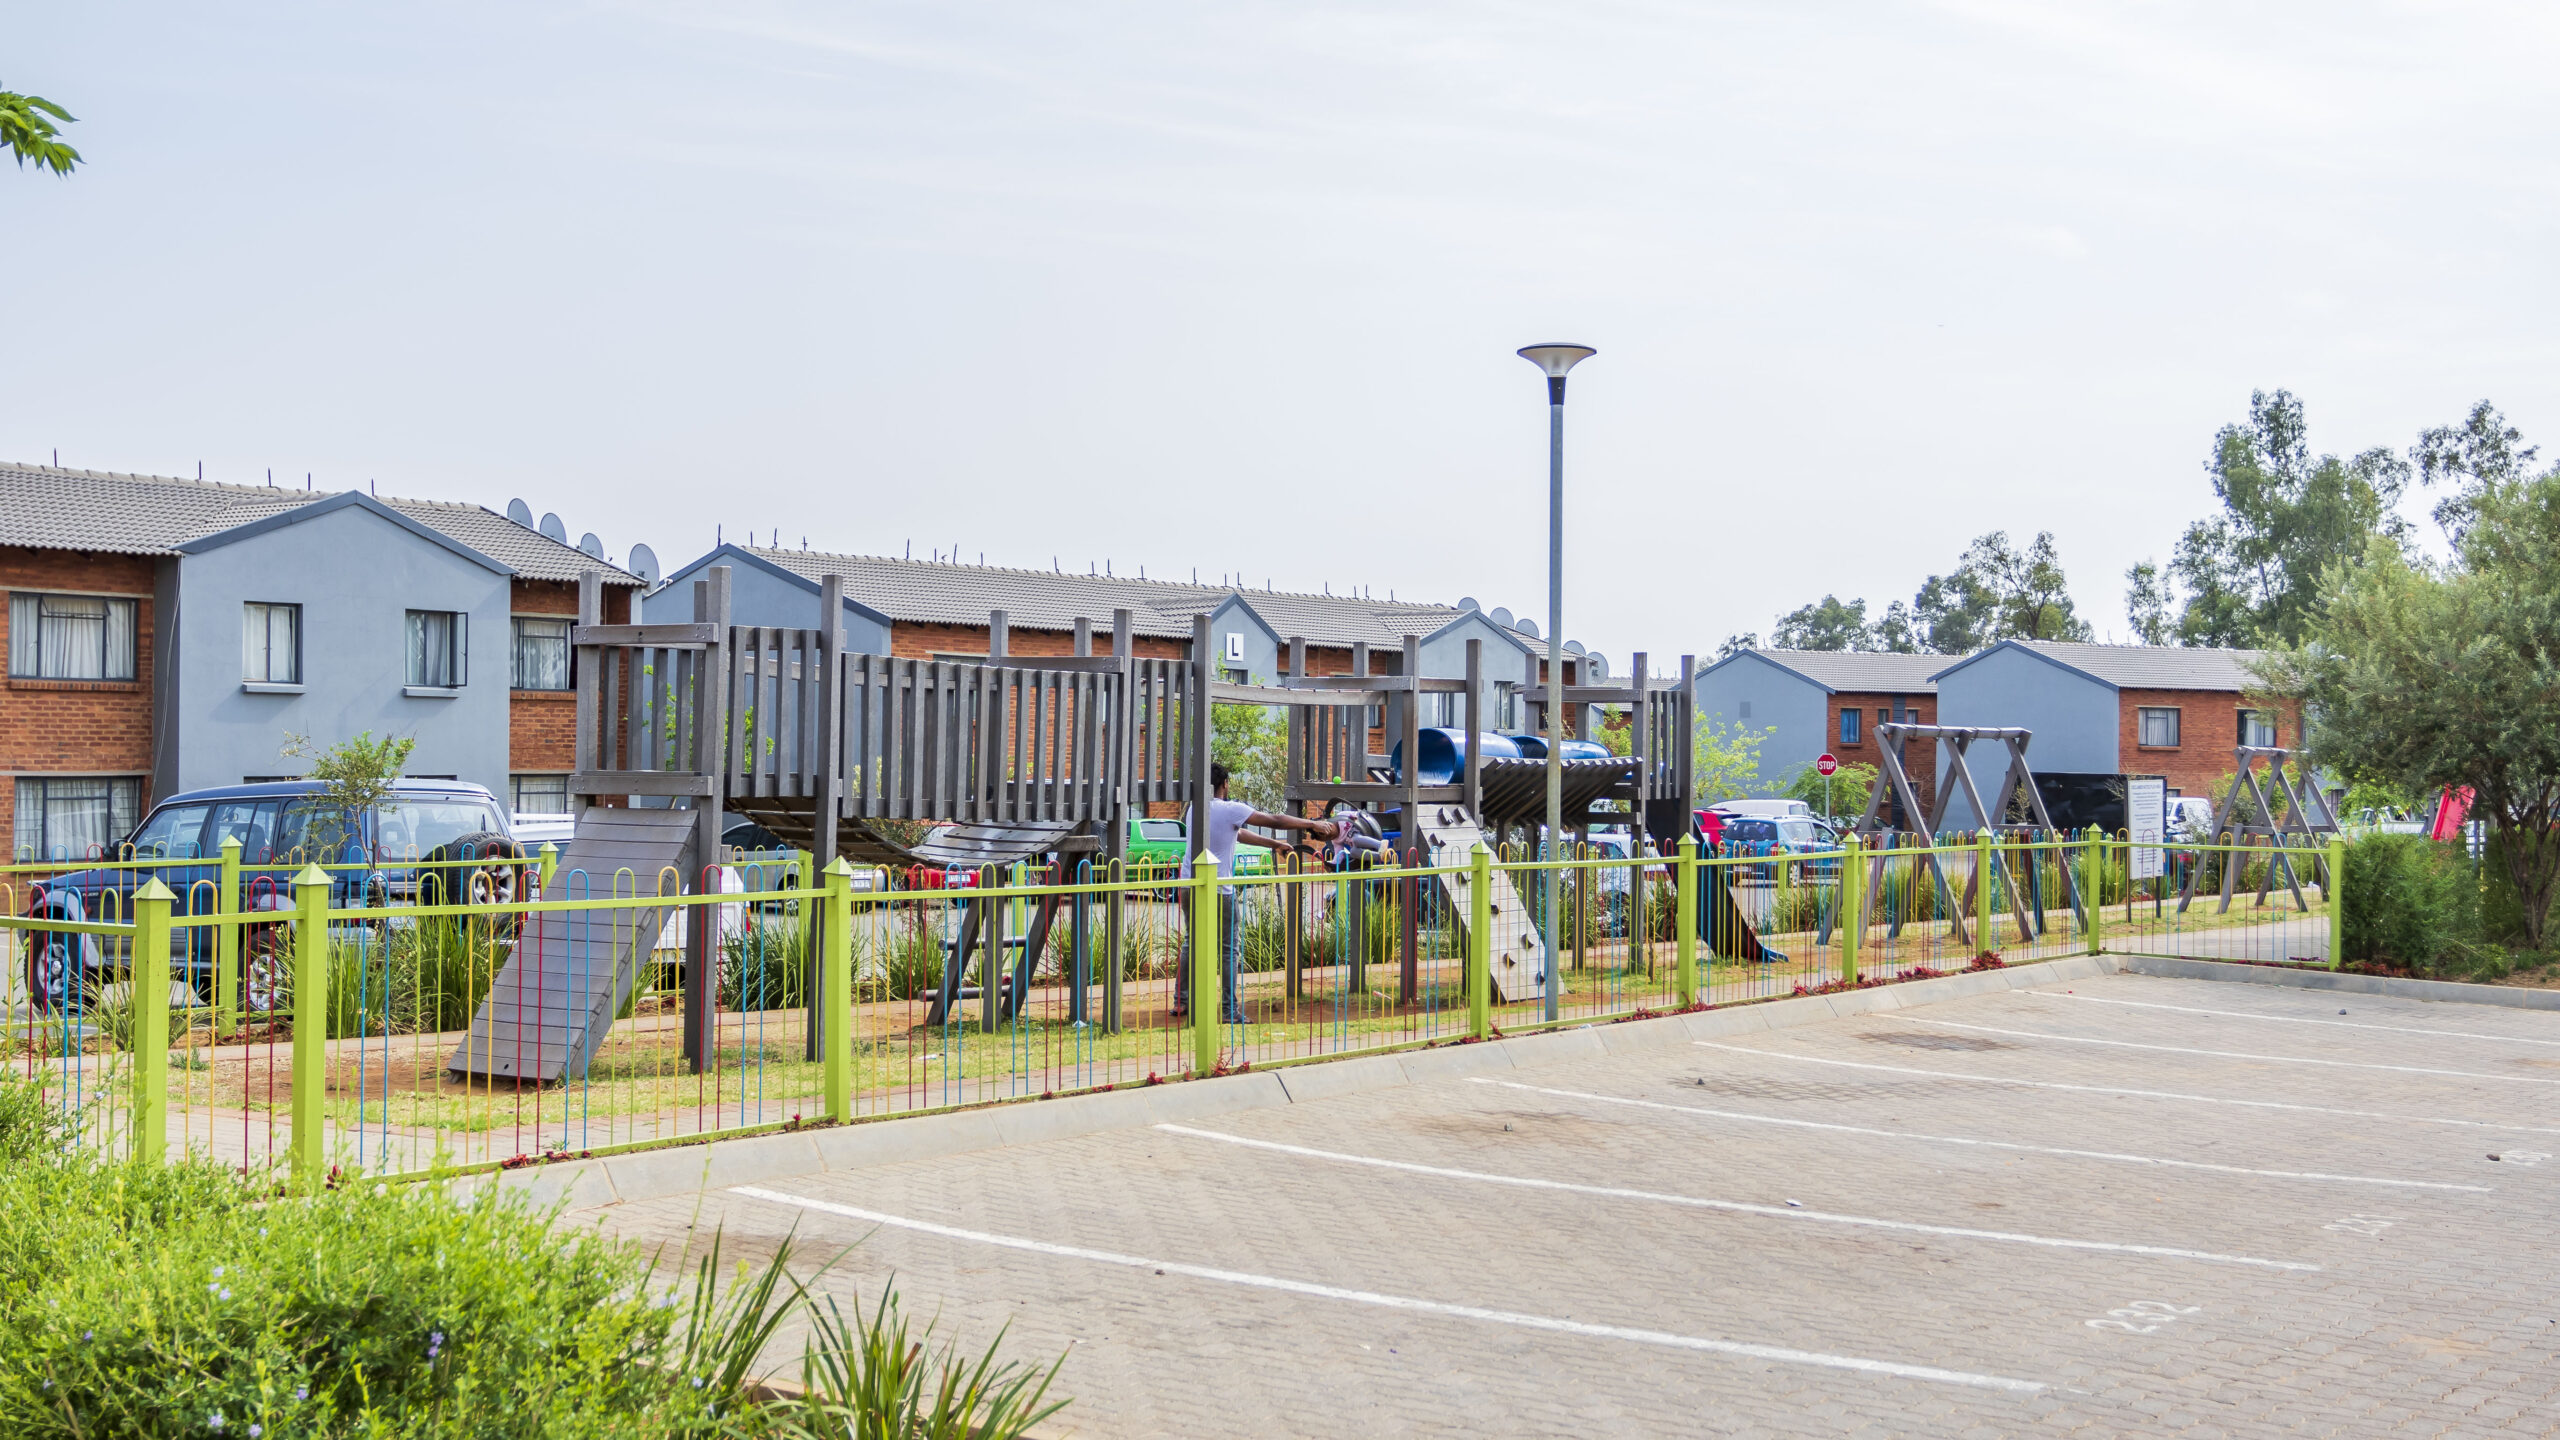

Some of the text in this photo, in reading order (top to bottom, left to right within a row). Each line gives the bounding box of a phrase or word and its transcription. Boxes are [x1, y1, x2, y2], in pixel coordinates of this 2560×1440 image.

[1231, 637, 1239, 657] L
[1818, 760, 1835, 770] STOP
[2084, 1300, 2201, 1333] 232
